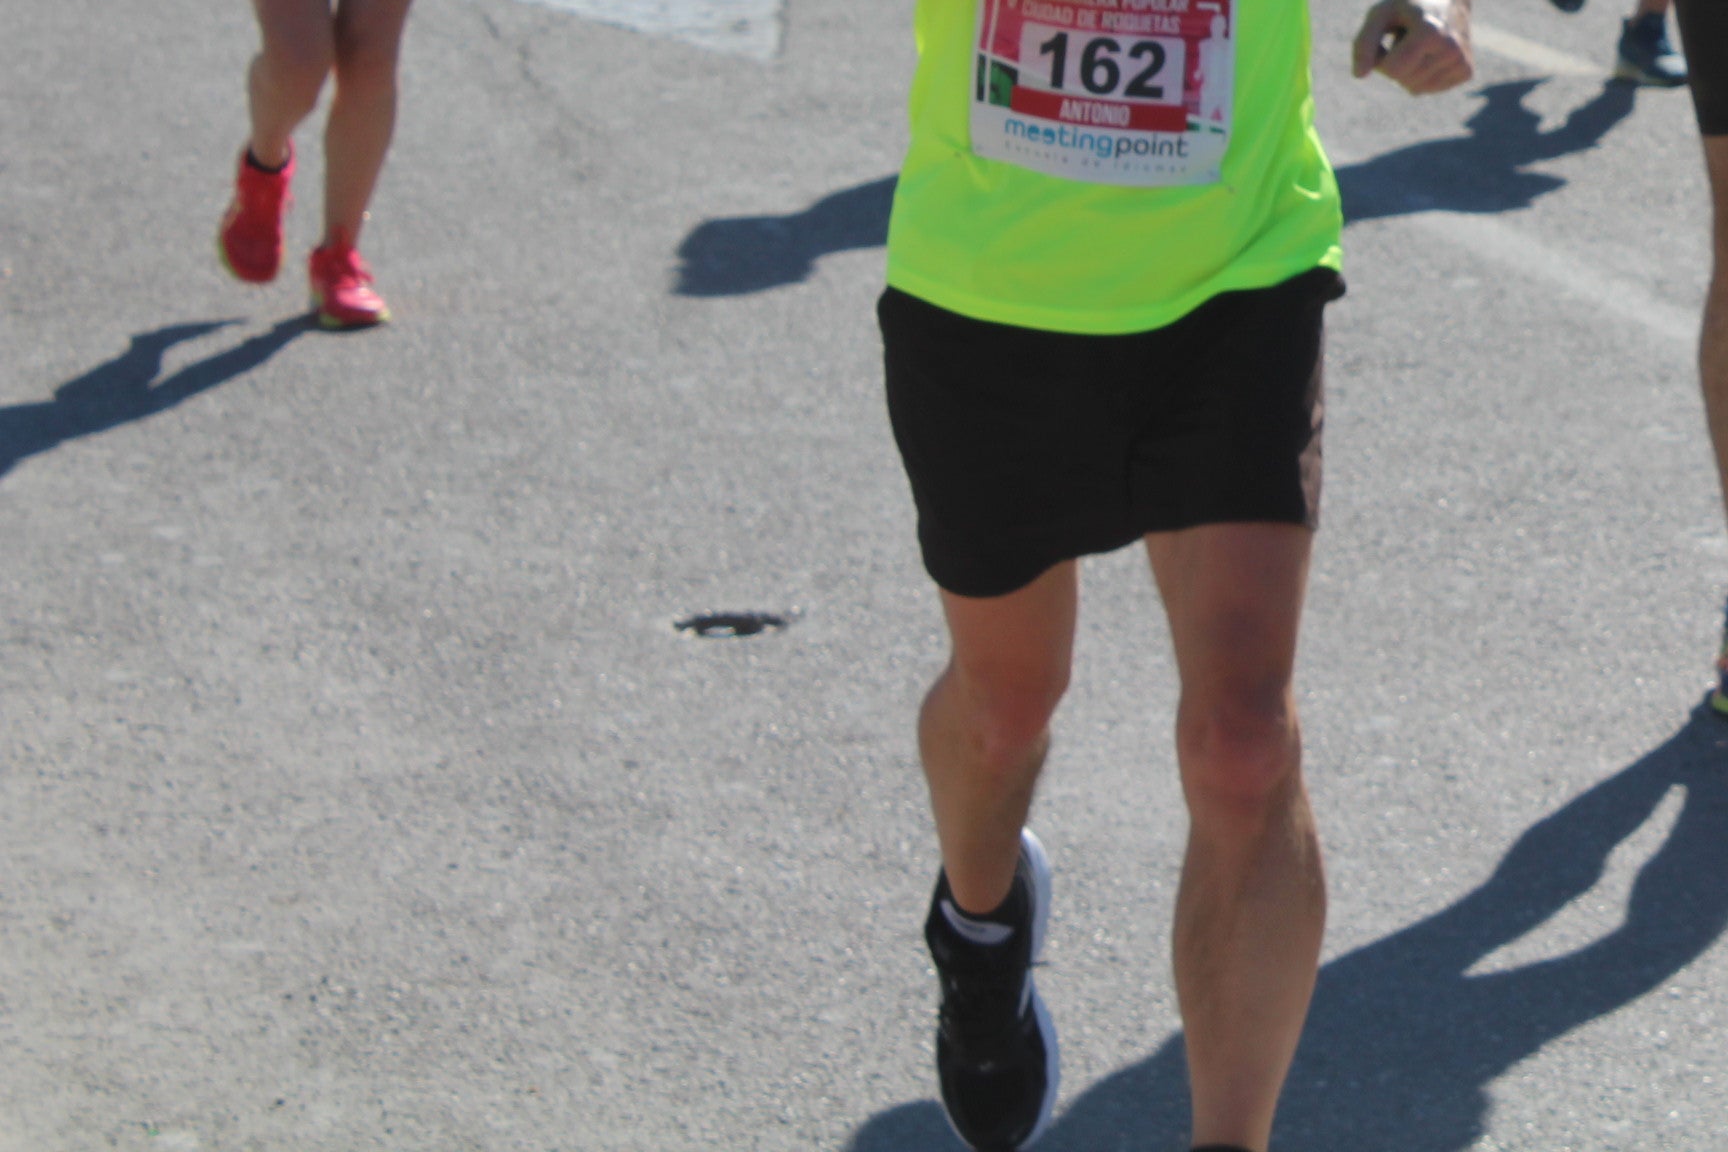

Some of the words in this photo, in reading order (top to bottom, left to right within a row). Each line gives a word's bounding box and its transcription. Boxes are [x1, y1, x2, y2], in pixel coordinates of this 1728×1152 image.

[1077, 9, 1097, 28] DE
[1040, 32, 1166, 99] 162
[1059, 99, 1132, 127] ANTONIO
[1005, 116, 1190, 160] meetingpoint
